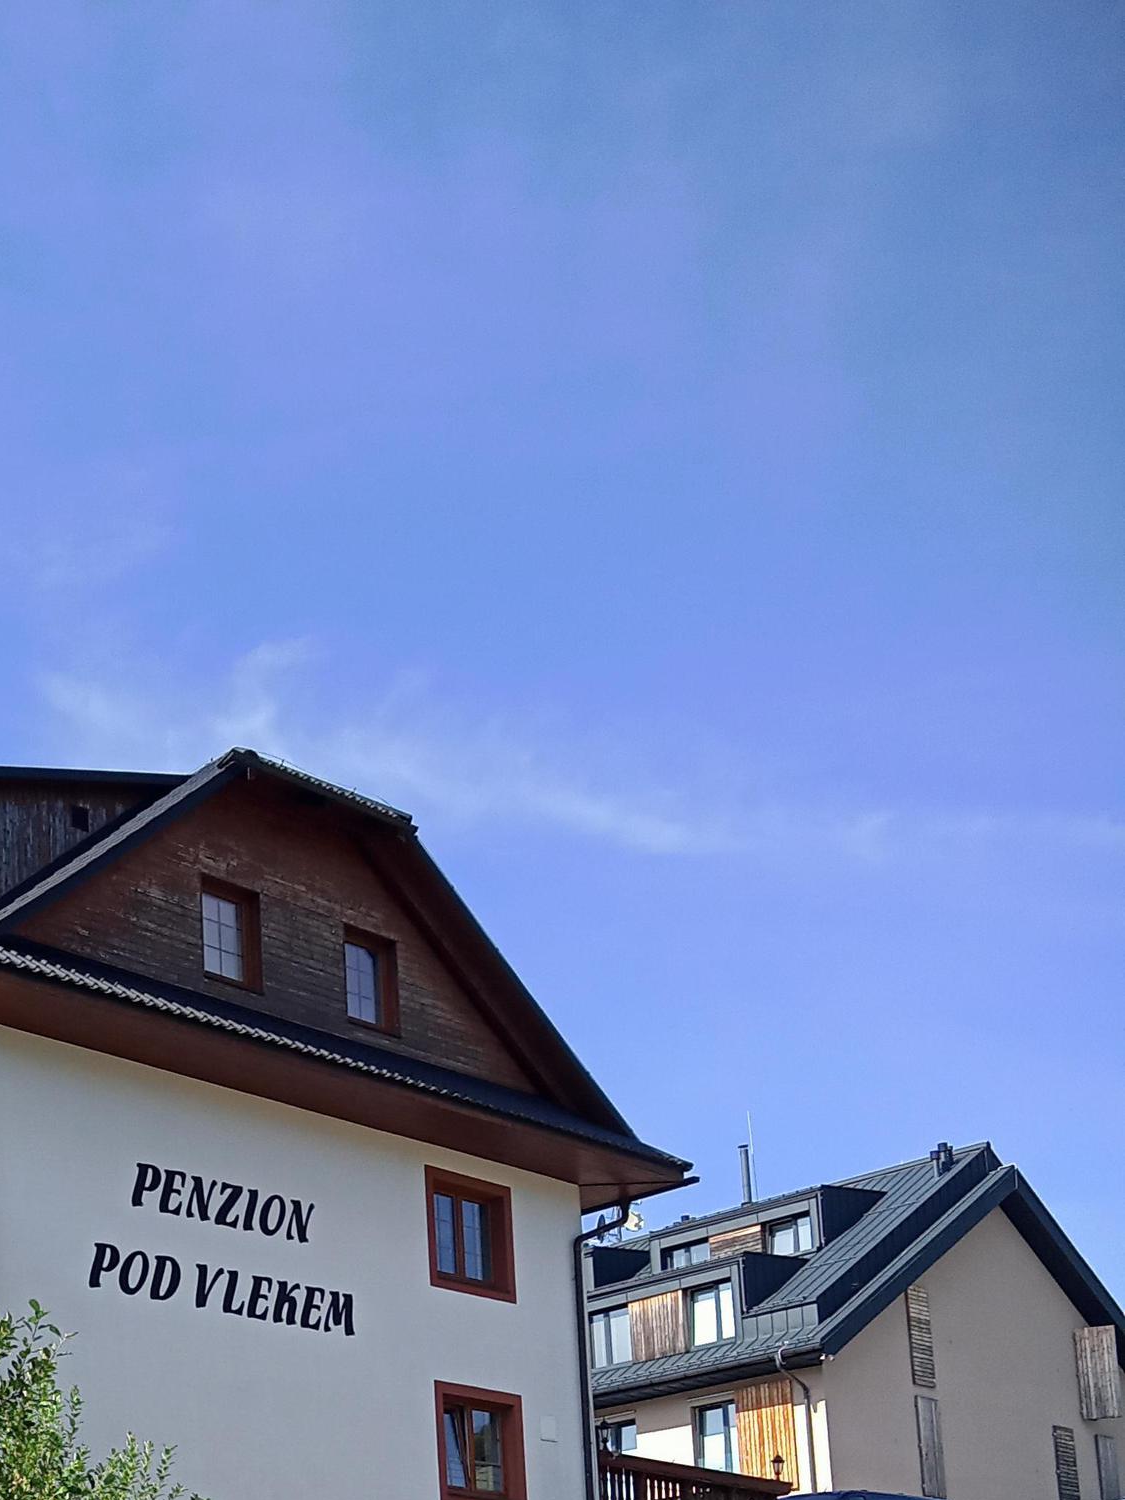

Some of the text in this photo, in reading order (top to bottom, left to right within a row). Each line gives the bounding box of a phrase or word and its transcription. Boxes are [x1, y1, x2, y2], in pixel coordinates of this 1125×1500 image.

[131, 1162, 315, 1243] PENZION
[88, 1242, 356, 1336] POD VLEKEM
